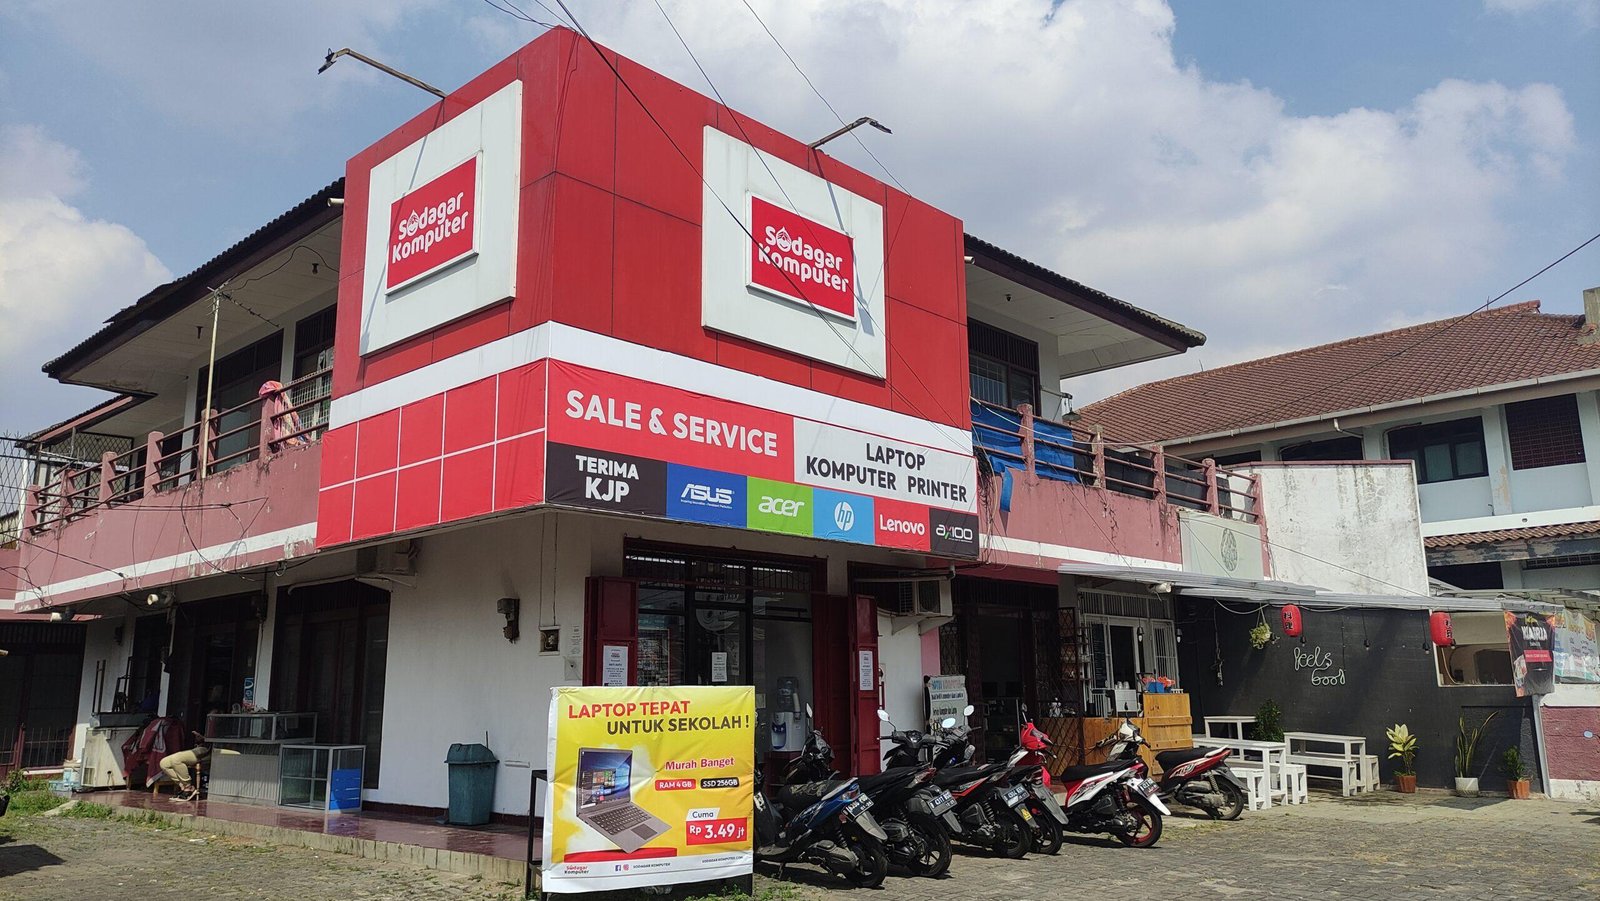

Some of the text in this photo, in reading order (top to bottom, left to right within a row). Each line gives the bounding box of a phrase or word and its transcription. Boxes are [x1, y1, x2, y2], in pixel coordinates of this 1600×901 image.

[398, 189, 464, 237] Sodagar
[392, 210, 468, 264] Komputer
[765, 225, 844, 272] Sodagar
[758, 242, 850, 293] Komputer
[565, 390, 778, 457] SALE & SERVICE
[575, 454, 640, 481] TERIMA
[866, 442, 926, 471] LAPTOP
[585, 476, 630, 503] KJP
[806, 456, 967, 503] KOMPUTER PRINTER
[681, 483, 733, 505] ASUS
[758, 495, 805, 518] acer
[836, 502, 853, 531] hp
[879, 514, 925, 536] Lenovo
[568, 700, 690, 719] LAPTOP TEPAT
[607, 718, 664, 735] UNTUK
[668, 715, 741, 732] SEKOLAH
[665, 757, 734, 770] Murah Banget
[659, 780, 692, 789] RAM 4 GB
[702, 779, 738, 788] SSD 256GB
[692, 811, 714, 819] Cuma
[689, 823, 745, 839] Rp 3.49 jt
